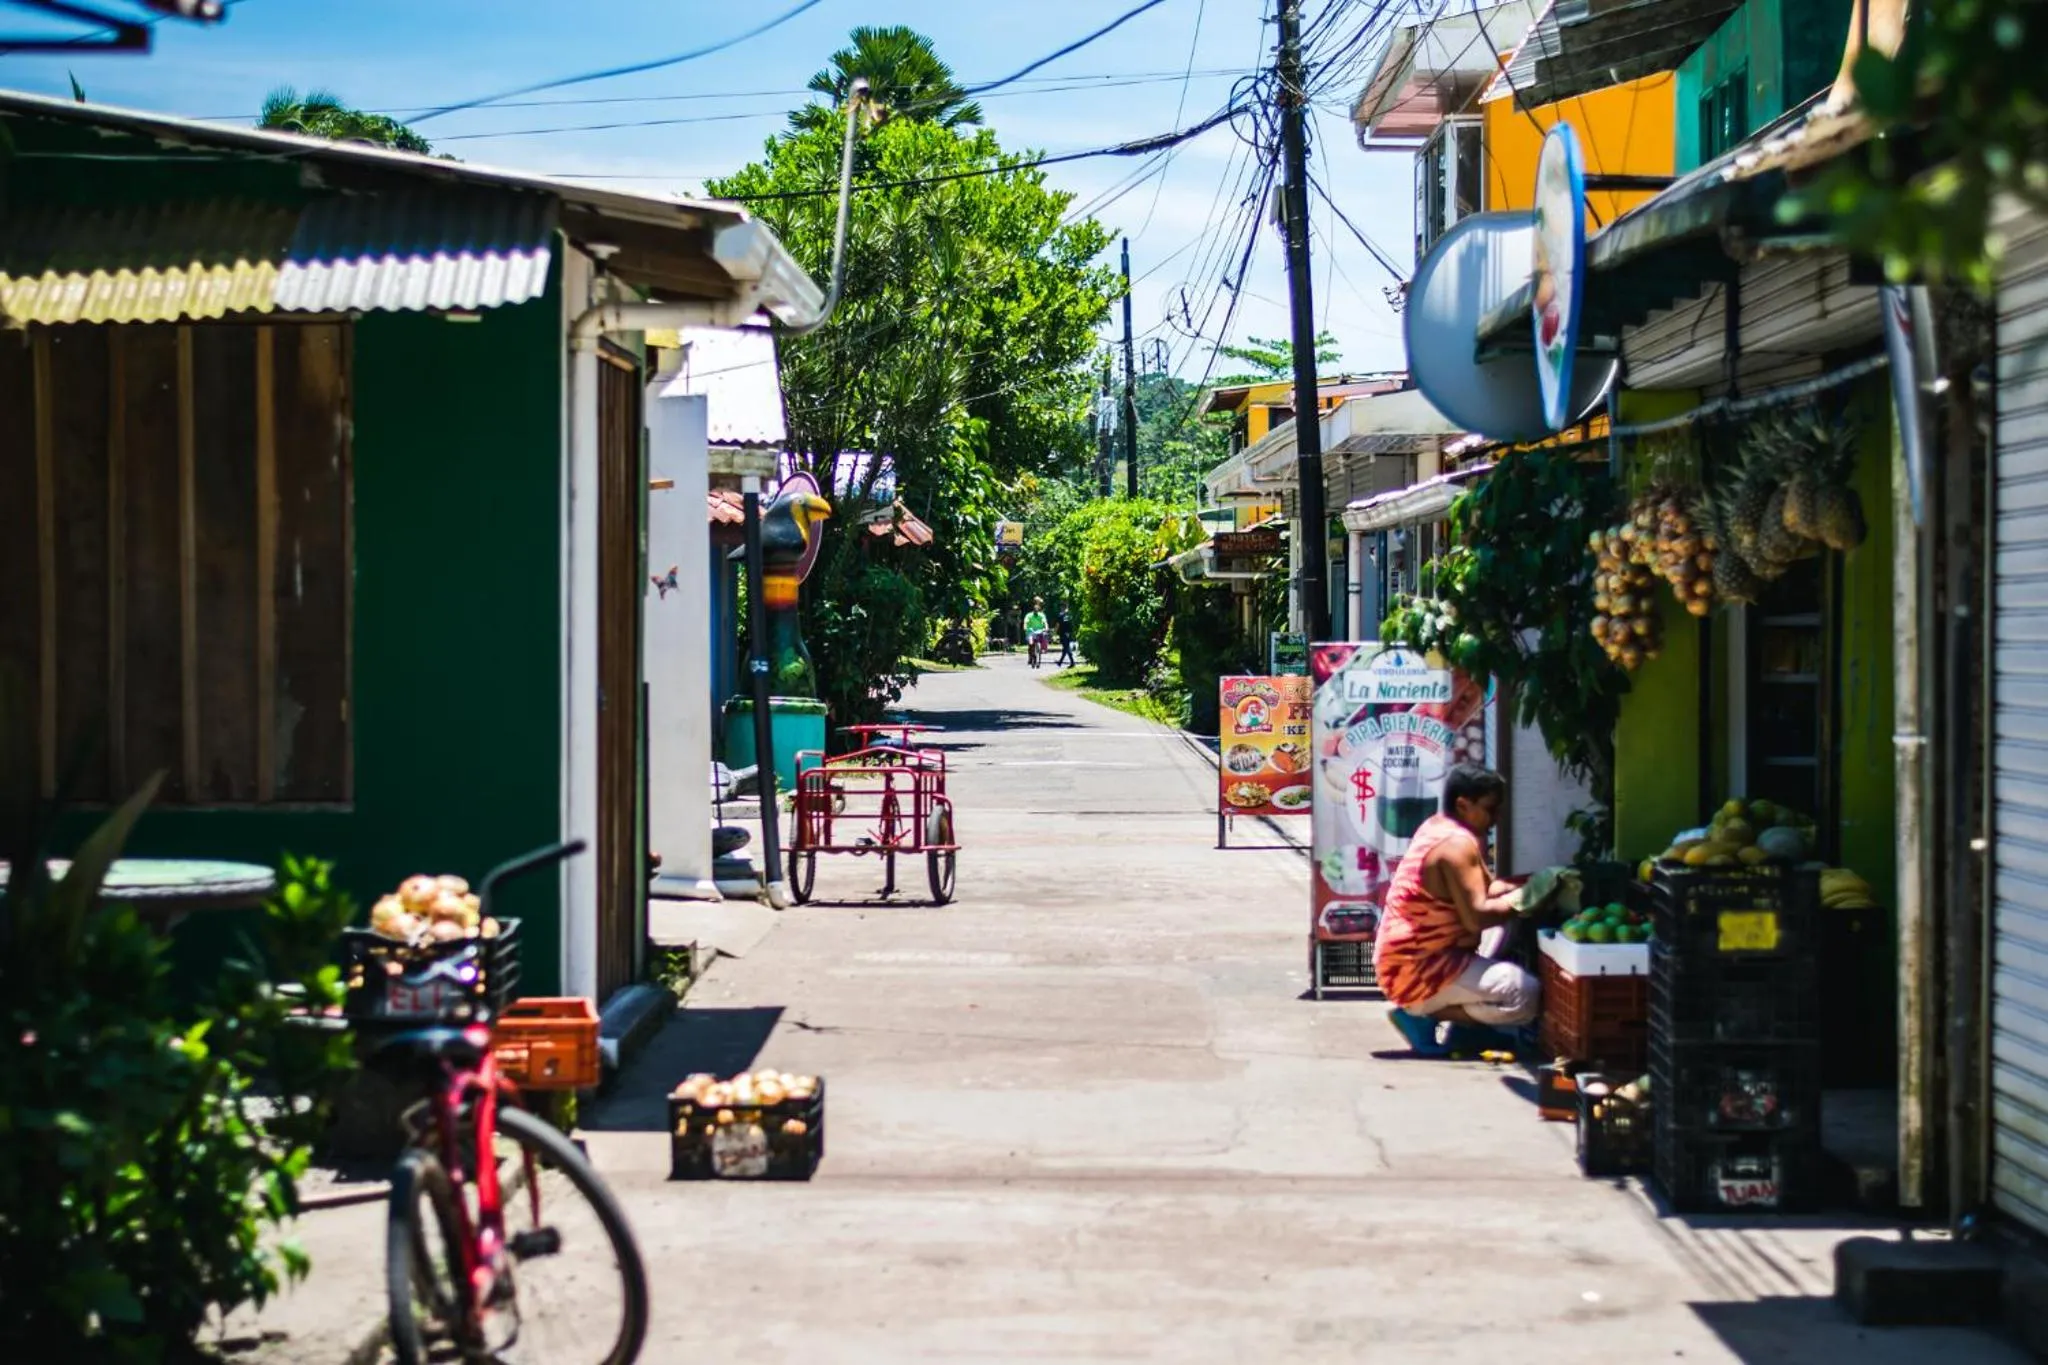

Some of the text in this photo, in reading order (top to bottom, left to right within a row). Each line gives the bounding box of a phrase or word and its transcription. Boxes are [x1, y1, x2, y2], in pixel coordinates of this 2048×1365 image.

[1349, 682, 1449, 699] La Naciente
[1346, 717, 1381, 746] PIPA
[1382, 714, 1417, 733] BIEN
[1387, 745, 1415, 756] WATER
